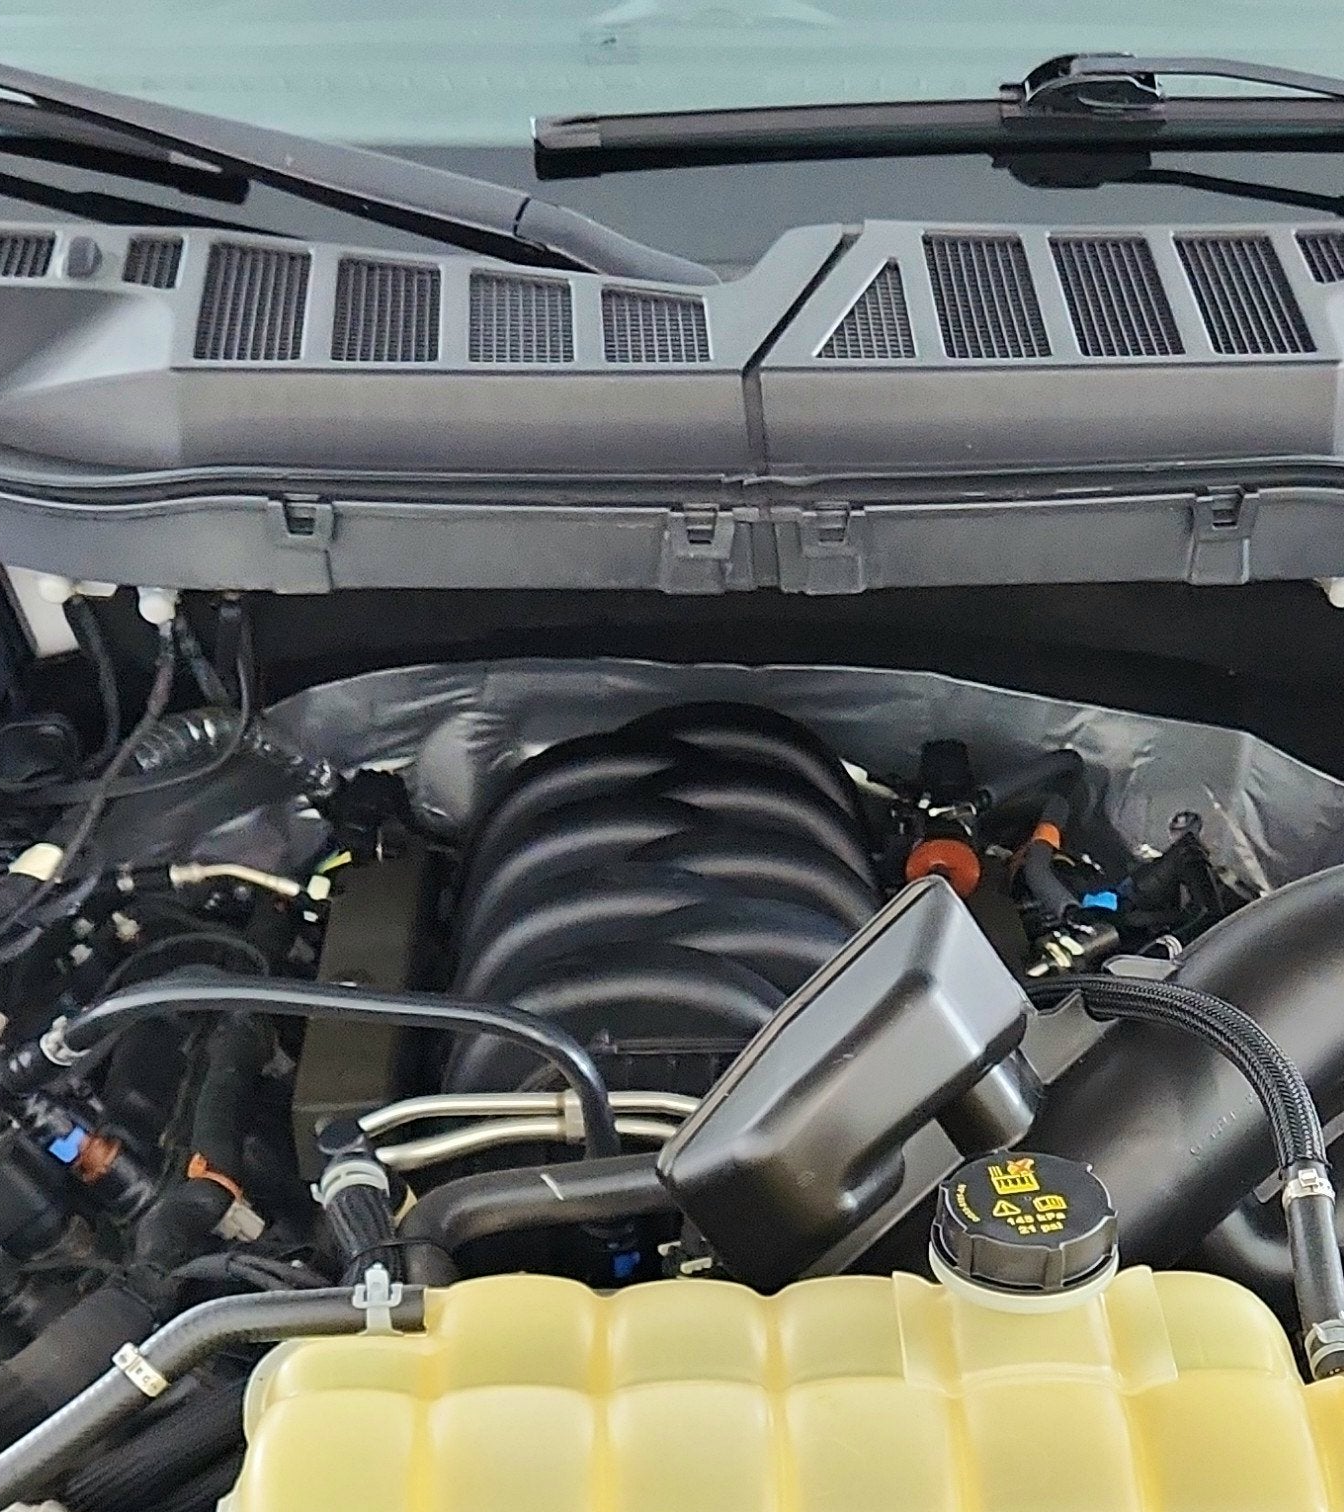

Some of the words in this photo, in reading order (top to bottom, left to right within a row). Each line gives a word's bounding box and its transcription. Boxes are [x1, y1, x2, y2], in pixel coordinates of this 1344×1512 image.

[1036, 1211, 1066, 1222] kPa
[1018, 1224, 1037, 1235] 21
[1040, 1221, 1064, 1234] psi
